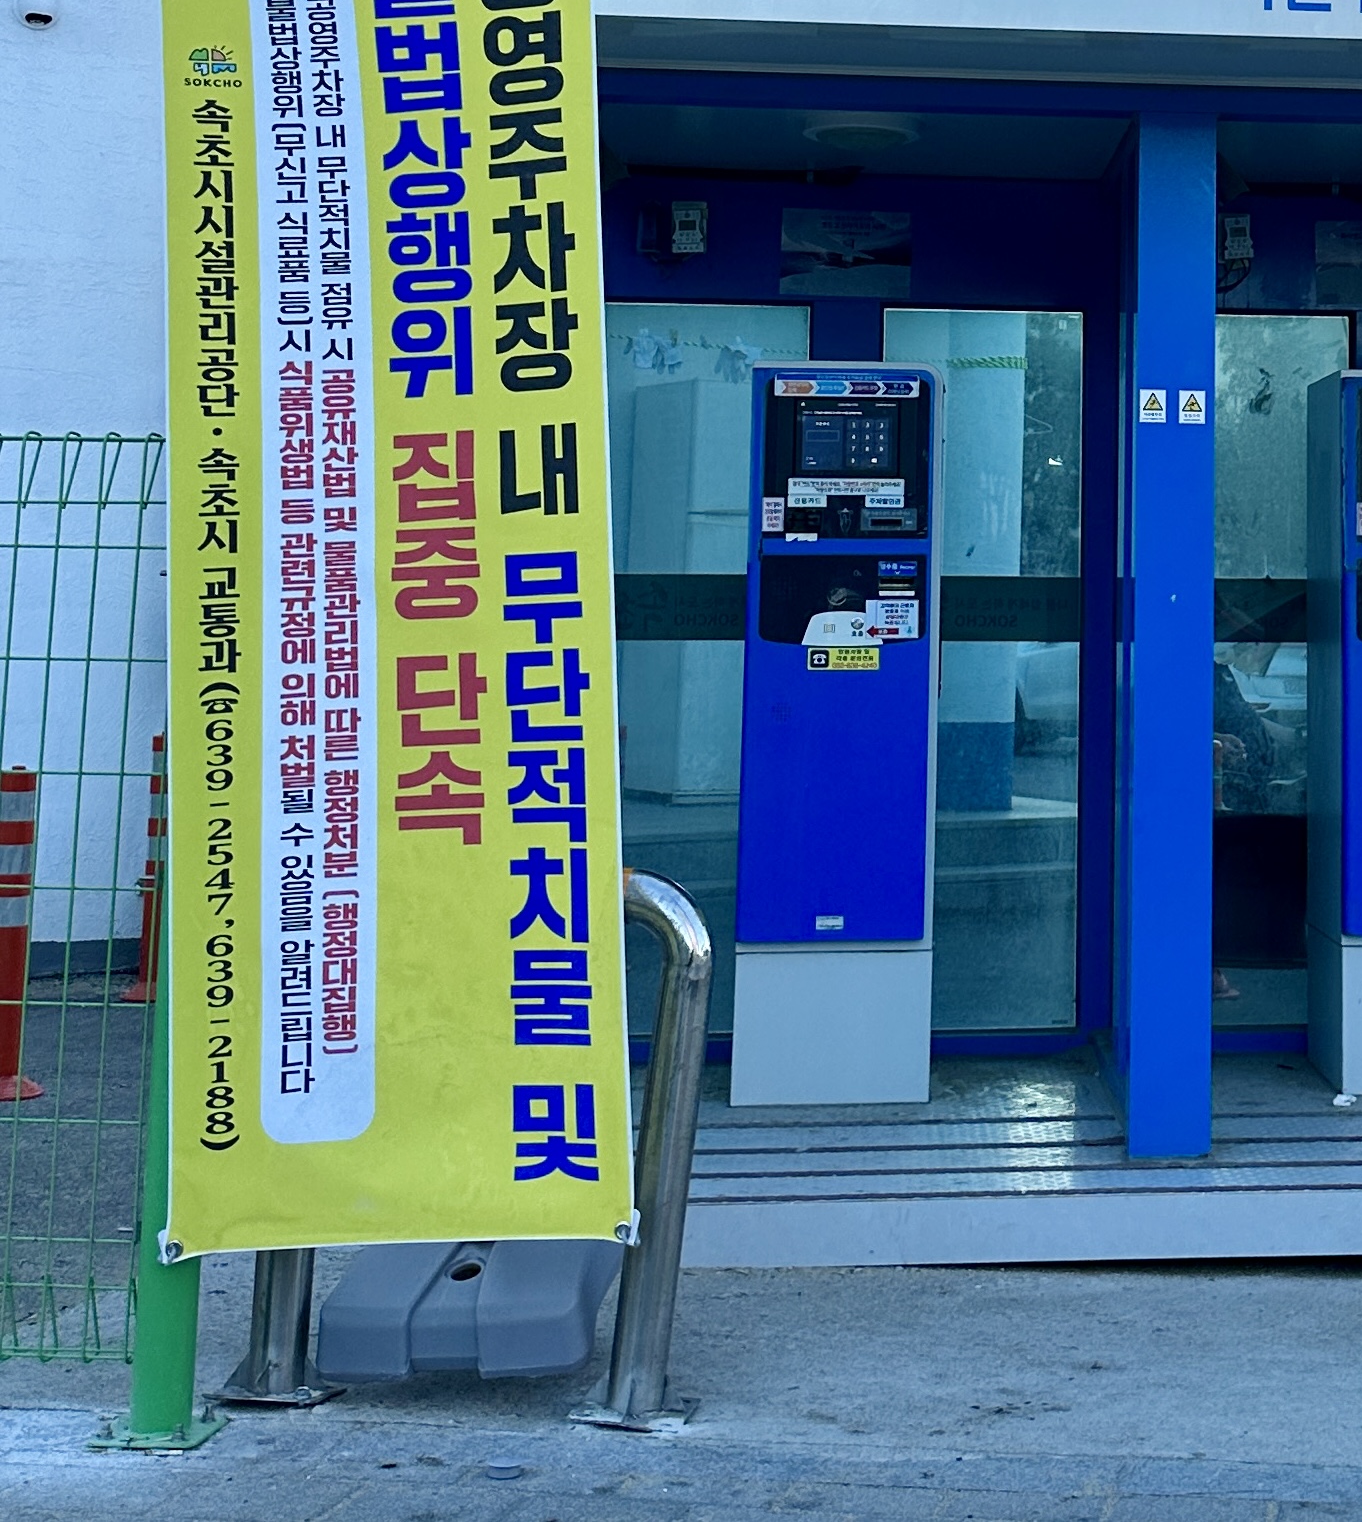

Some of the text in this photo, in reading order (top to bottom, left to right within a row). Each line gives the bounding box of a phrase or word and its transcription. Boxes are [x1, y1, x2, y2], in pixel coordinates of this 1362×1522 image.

[183, 77, 243, 89] SOKCHO
[315, 124, 347, 148] 내
[192, 98, 240, 418] 속초시시설관리공단
[276, 211, 311, 283] 식료품
[316, 156, 351, 275] 무단적치물
[320, 282, 354, 330] 점유
[321, 337, 354, 361] 시
[278, 360, 315, 491] 식품위생법
[320, 368, 359, 499] 공유재산법
[499, 422, 580, 516] 내
[197, 447, 241, 554] 속초시
[279, 498, 316, 525] 등
[323, 506, 358, 533] 및
[391, 429, 481, 620] 집중
[279, 532, 318, 665] 관련규정에
[322, 540, 361, 699] 물품관리법에
[279, 673, 316, 727] 의해
[323, 707, 362, 762] 따른
[279, 734, 316, 815] 처벌될
[394, 652, 488, 846] 단속
[279, 822, 315, 847] 수
[321, 769, 360, 879] 행정처분
[502, 550, 593, 1046] 무단적치물
[279, 854, 315, 933] 있음을
[279, 939, 316, 1095] 알려드립니다
[512, 1083, 600, 1182] 및
